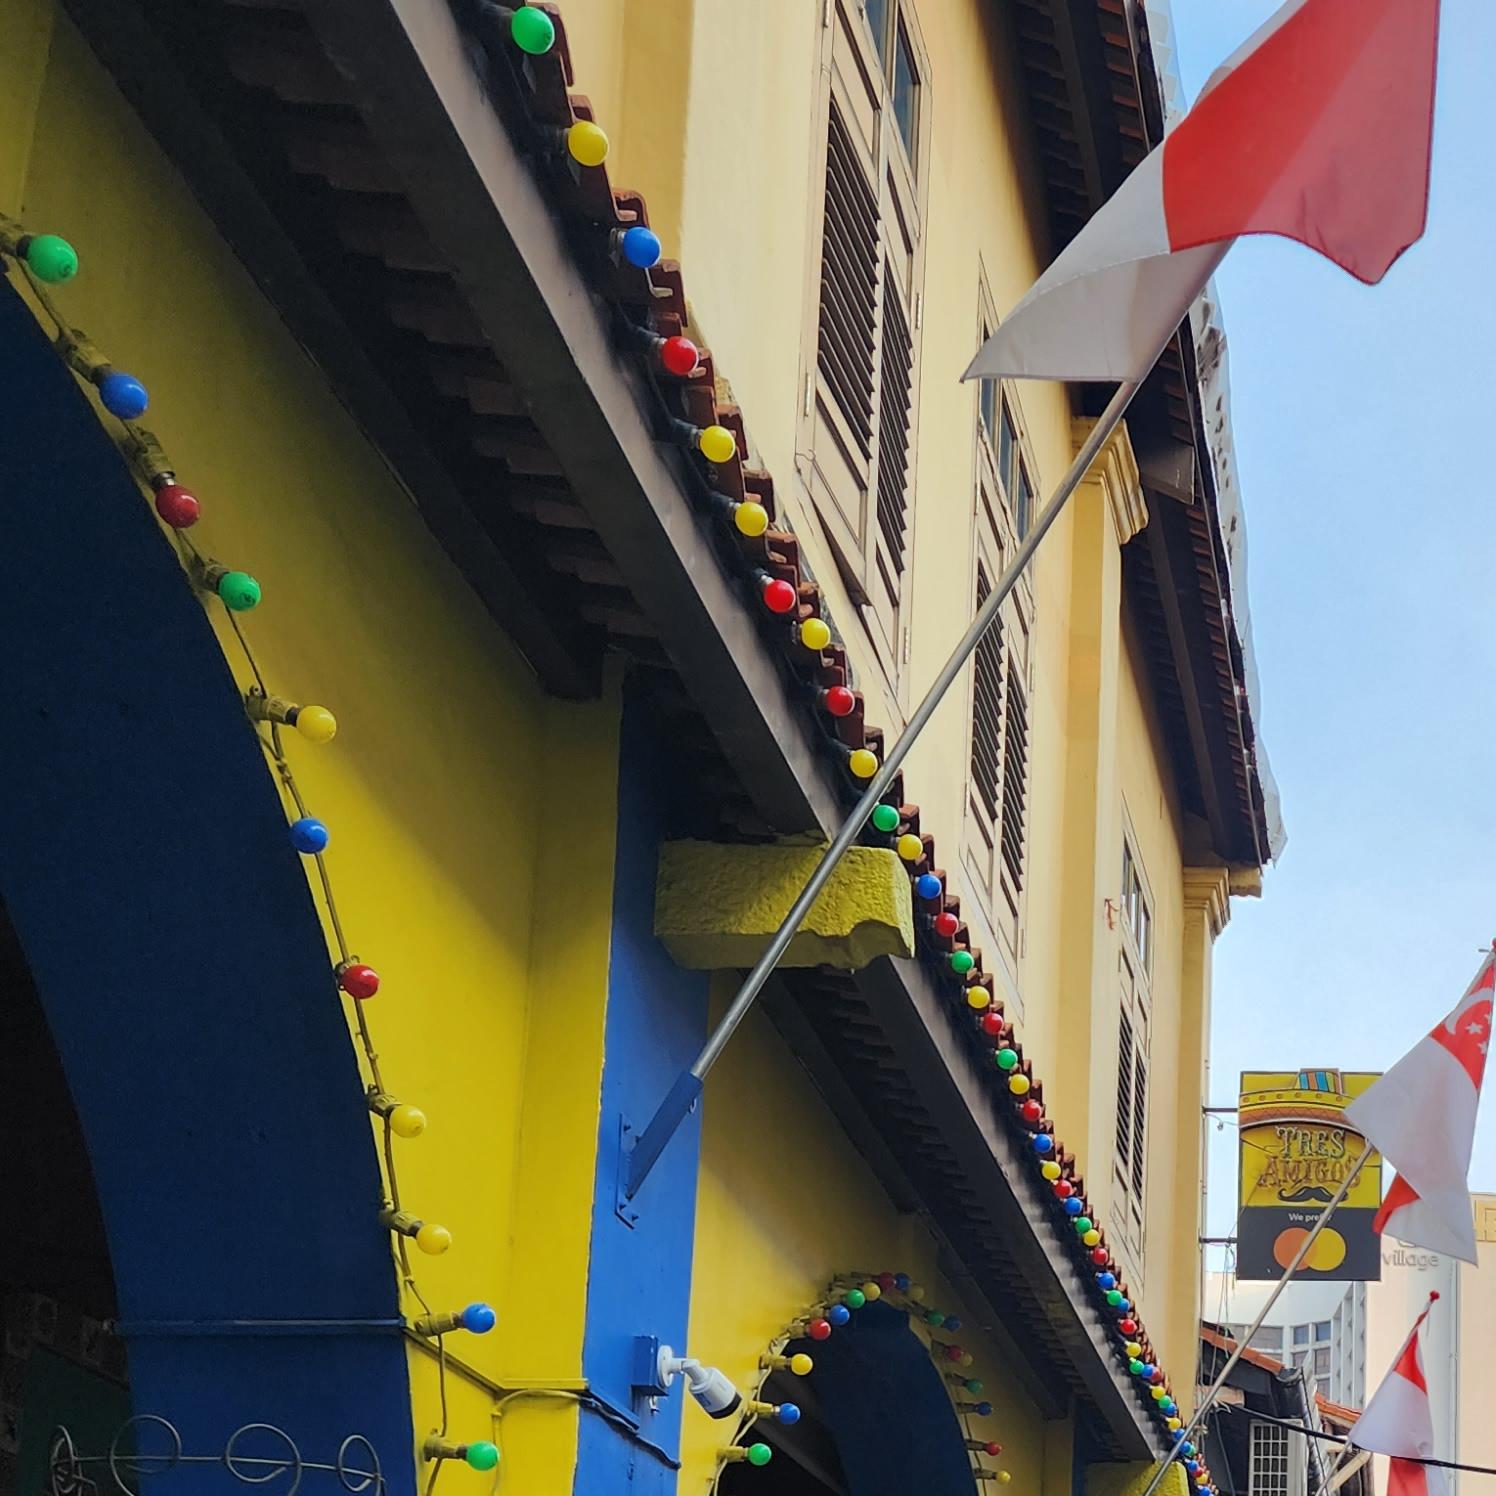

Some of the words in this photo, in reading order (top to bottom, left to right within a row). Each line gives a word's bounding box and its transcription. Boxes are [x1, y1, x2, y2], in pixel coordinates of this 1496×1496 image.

[1275, 1125, 1345, 1158] TRES
[1288, 1213, 1304, 1221] We
[1382, 1250, 1440, 1271] village
